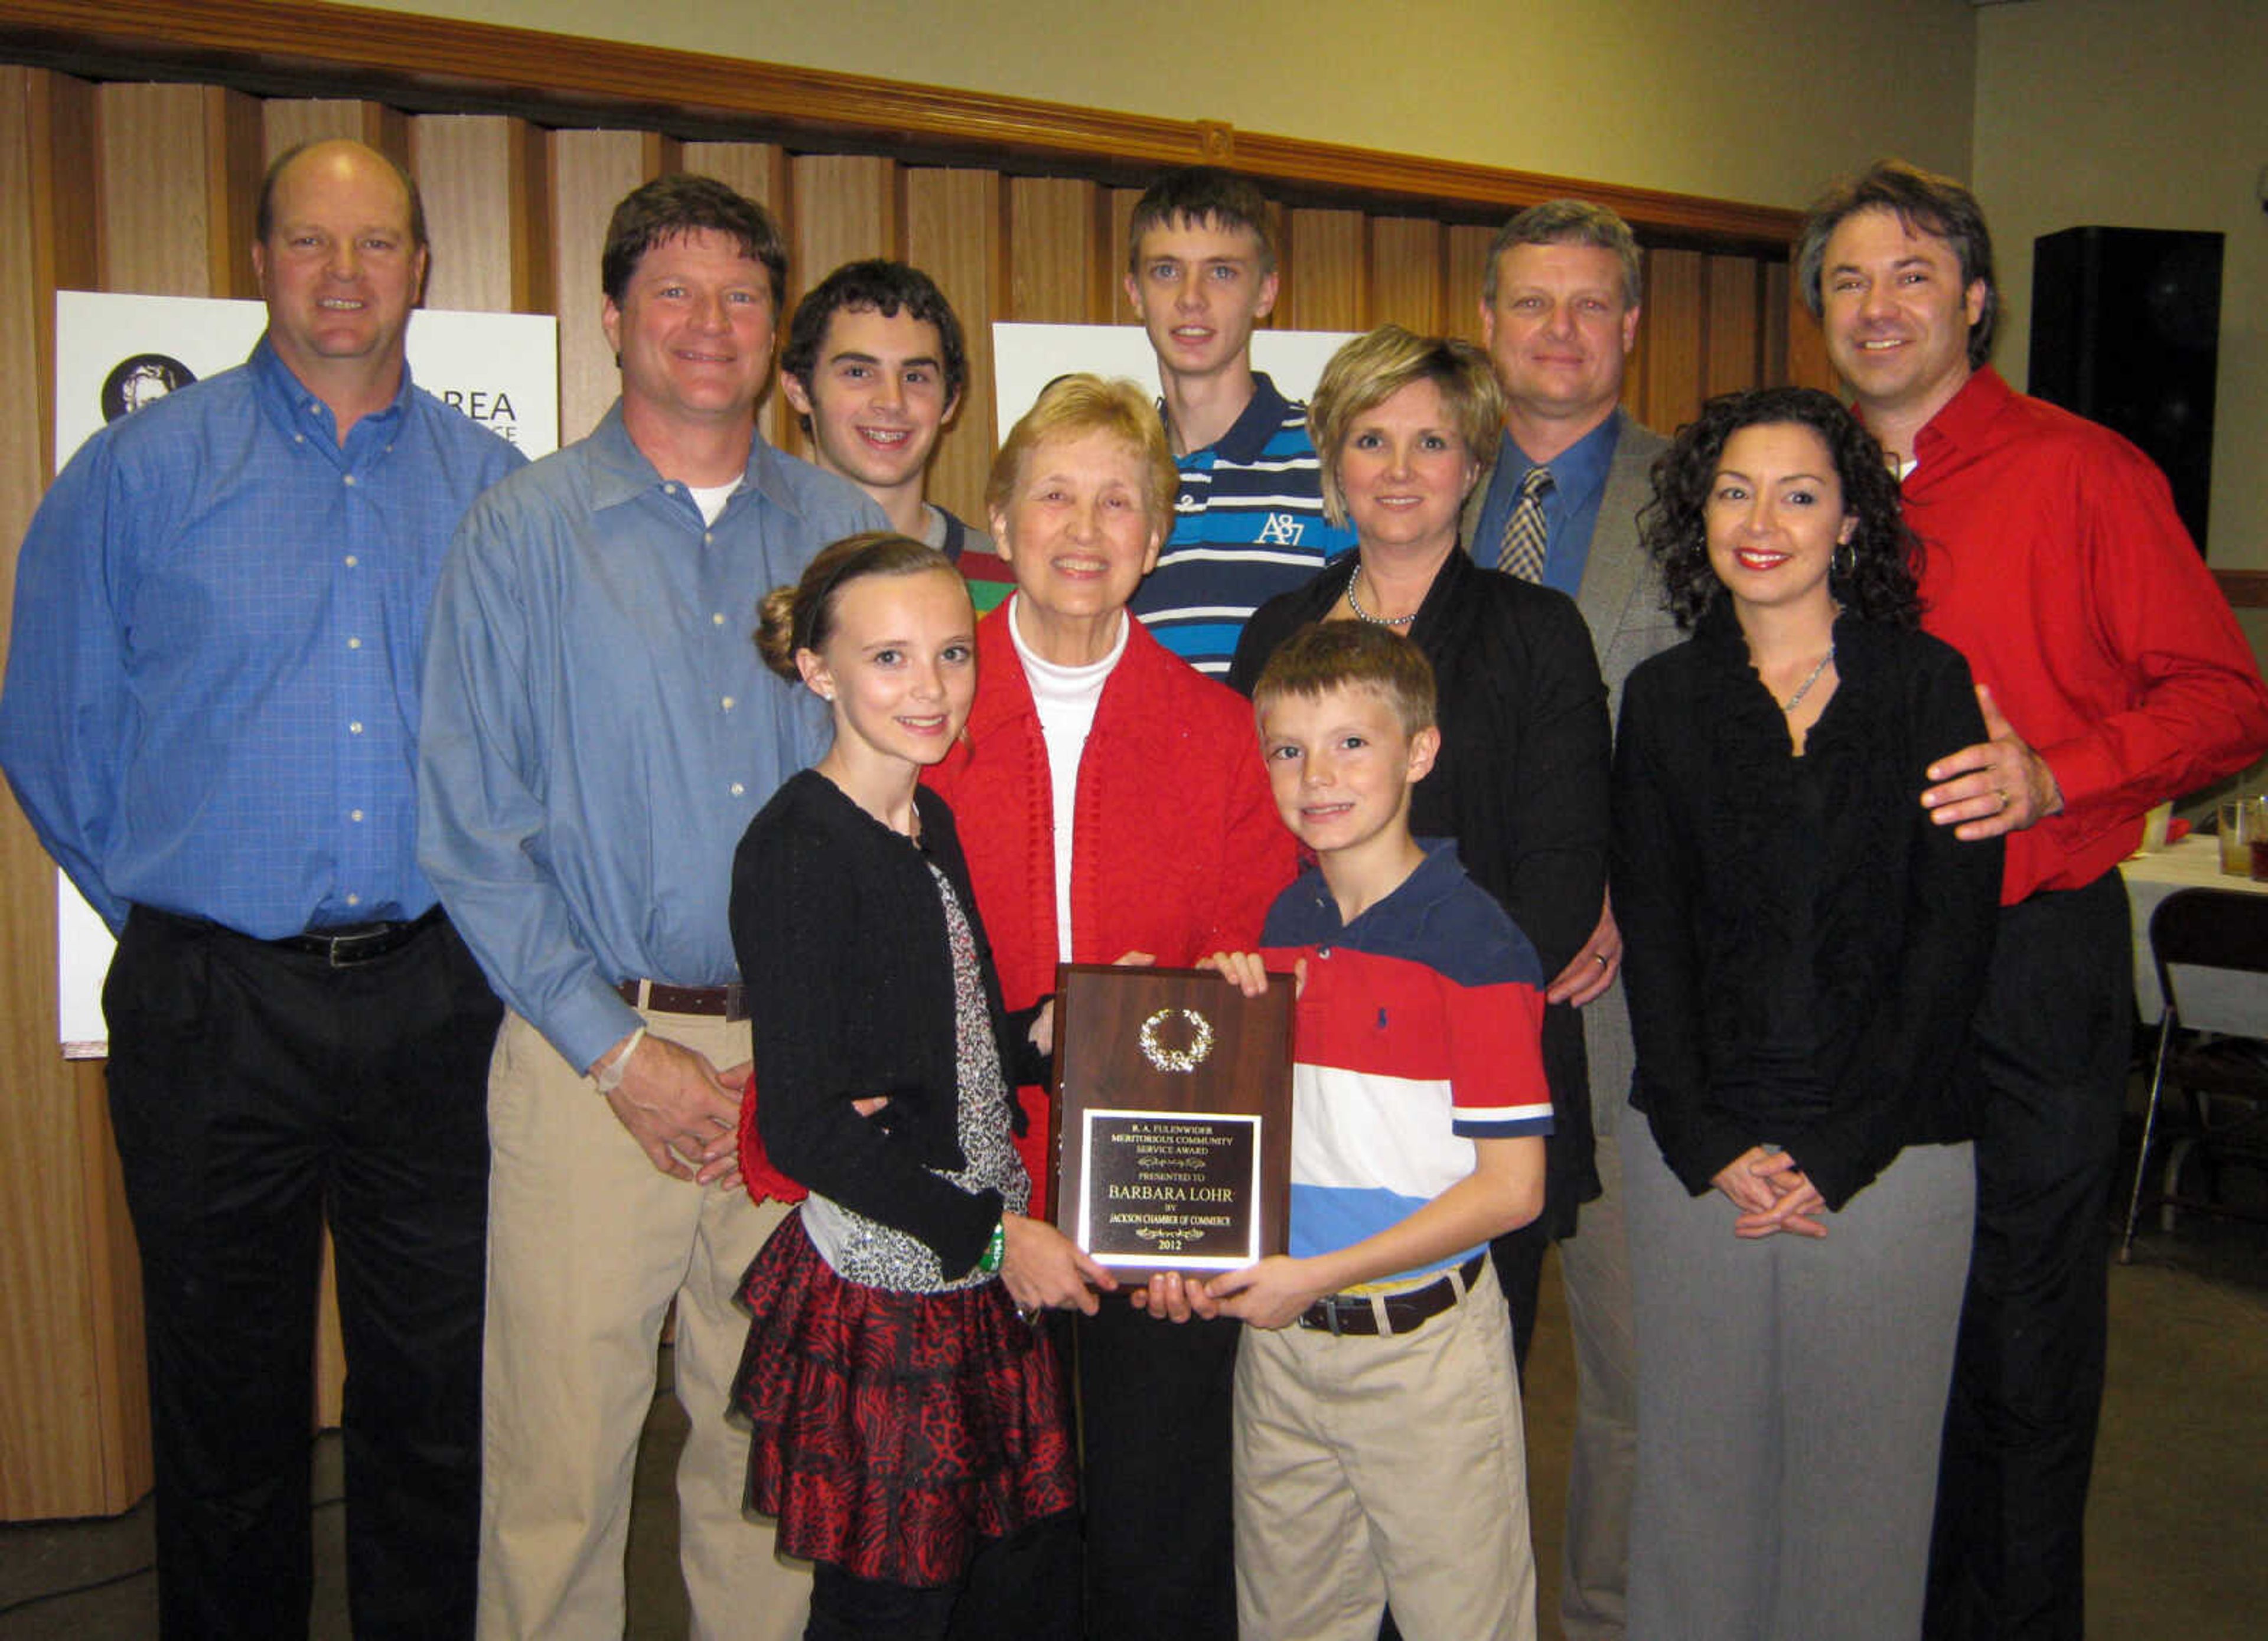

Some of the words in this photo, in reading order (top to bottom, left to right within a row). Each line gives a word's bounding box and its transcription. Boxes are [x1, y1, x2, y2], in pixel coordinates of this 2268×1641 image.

[1111, 1134, 1174, 1143] MERITORIOUS
[1175, 1136, 1233, 1146] COMMUNITY
[1136, 1145, 1174, 1154] SERVICE
[1177, 1146, 1209, 1155] AWARD
[1138, 1172, 1191, 1181] PRESENTED
[1192, 1173, 1205, 1182] TO
[1109, 1184, 1186, 1201] BARBARA
[1190, 1186, 1234, 1203] LOHR
[1109, 1212, 1142, 1224] JACKSON
[1190, 1215, 1231, 1226] COMMERCE
[1158, 1239, 1182, 1251] 2012
